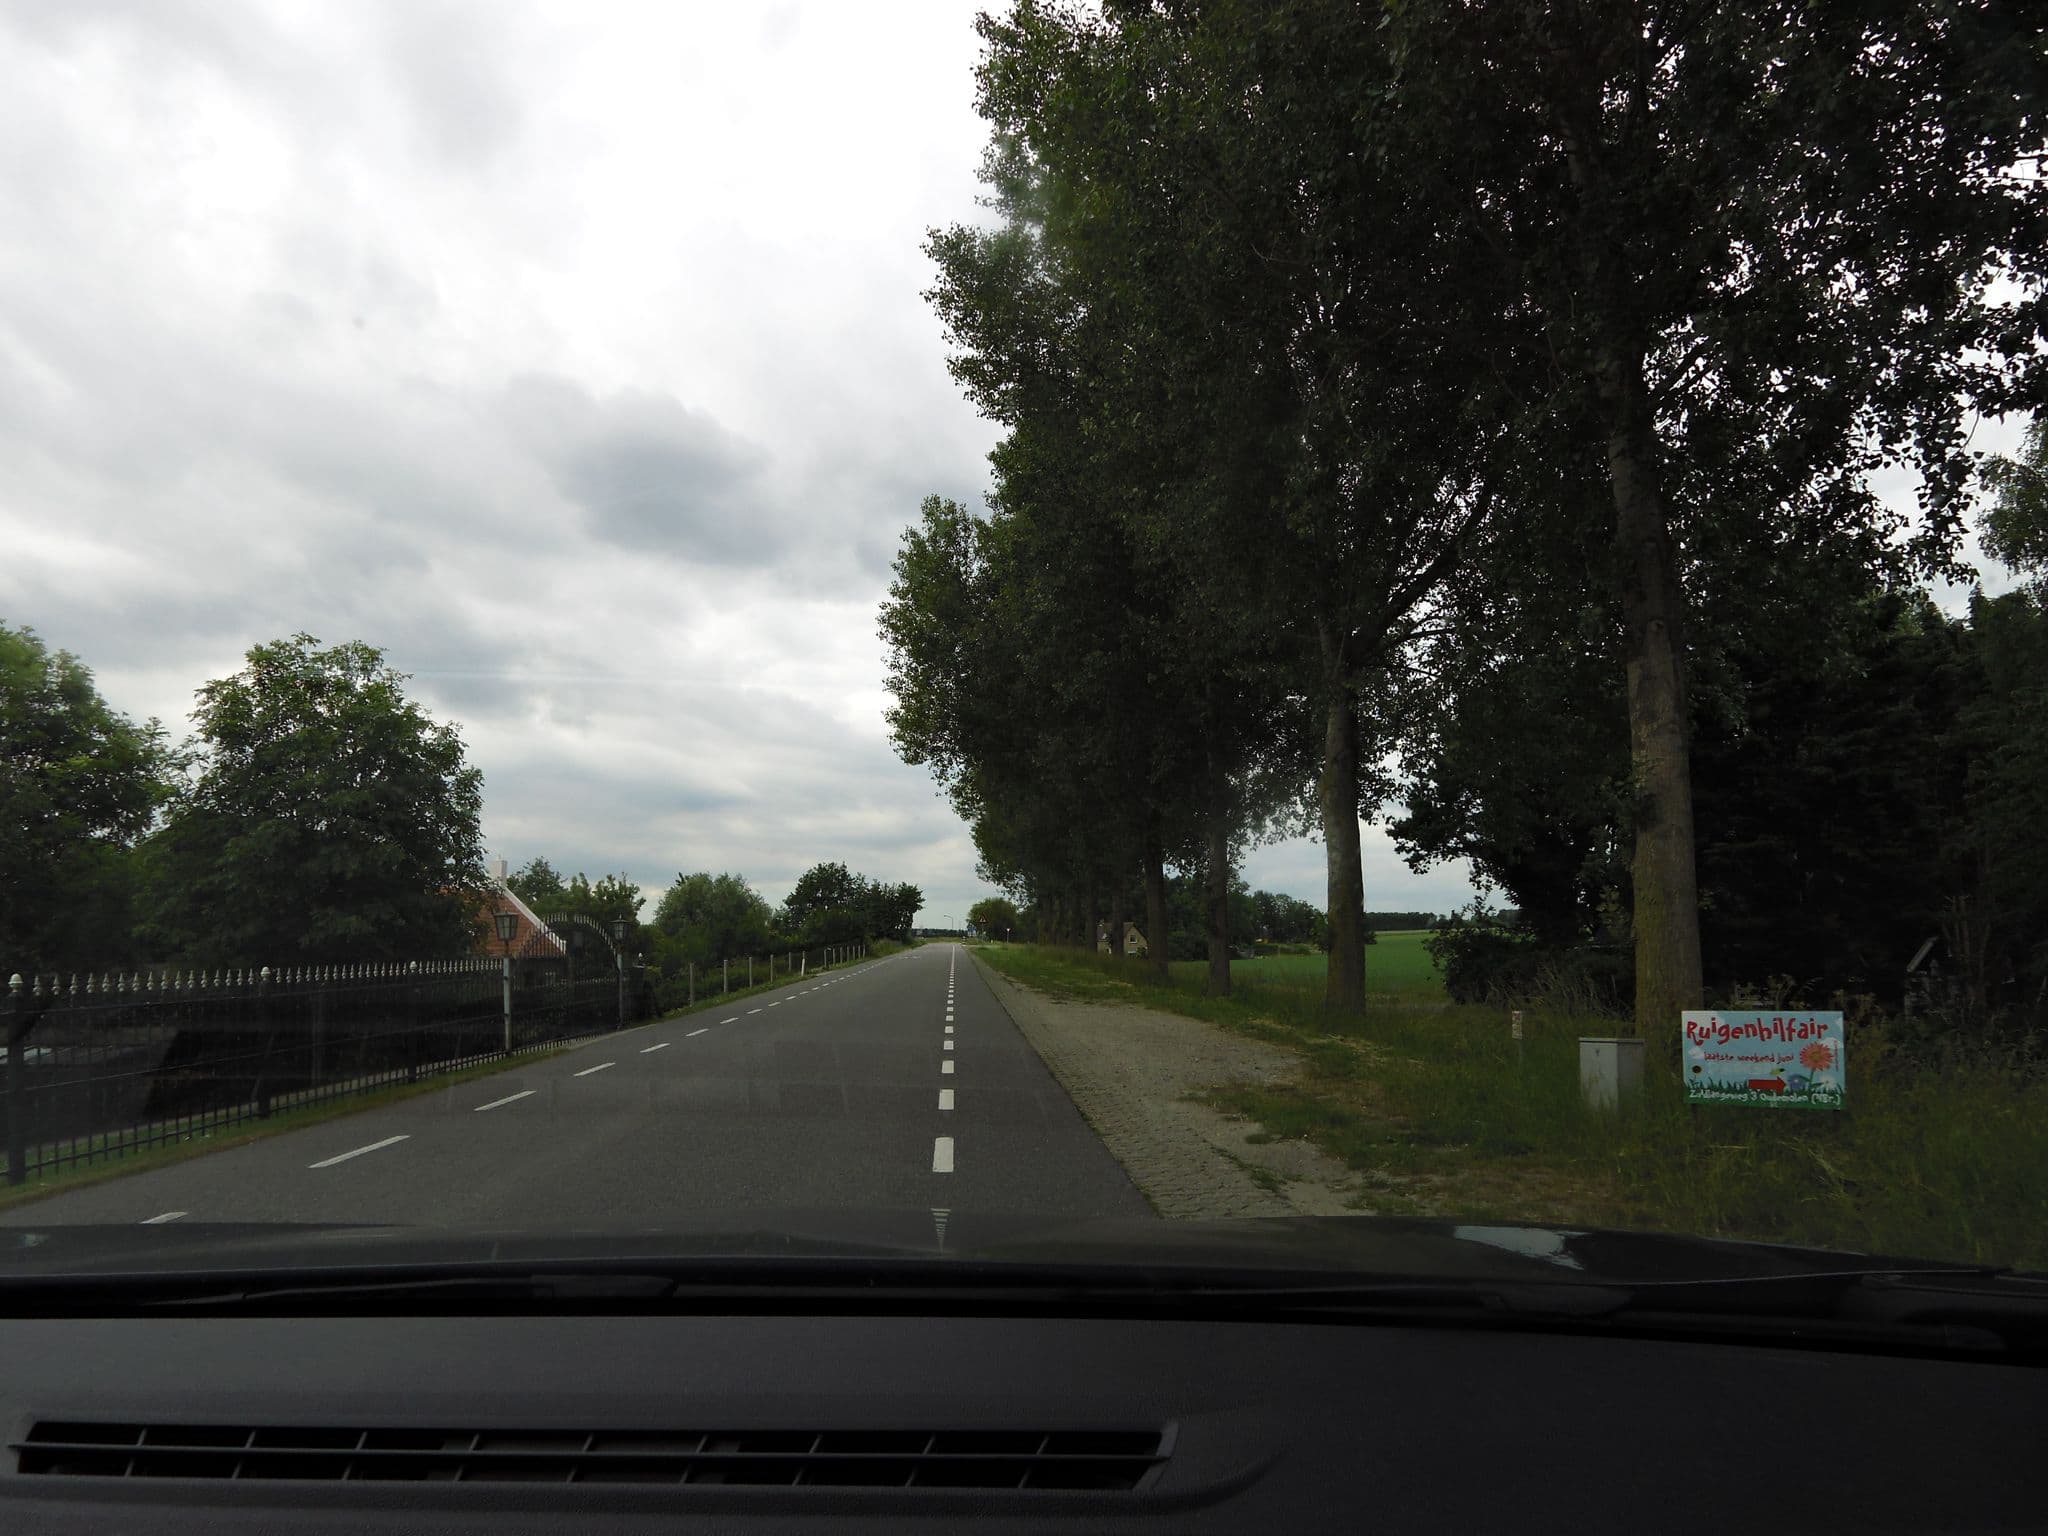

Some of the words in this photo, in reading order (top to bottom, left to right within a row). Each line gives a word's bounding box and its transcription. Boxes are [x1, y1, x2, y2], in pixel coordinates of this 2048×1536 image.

[1686, 1016, 1828, 1046] Ruigenhilfair
[1704, 1051, 1734, 1061] laatste
[1737, 1052, 1775, 1062] weekend
[1750, 1090, 1757, 1100] 3
